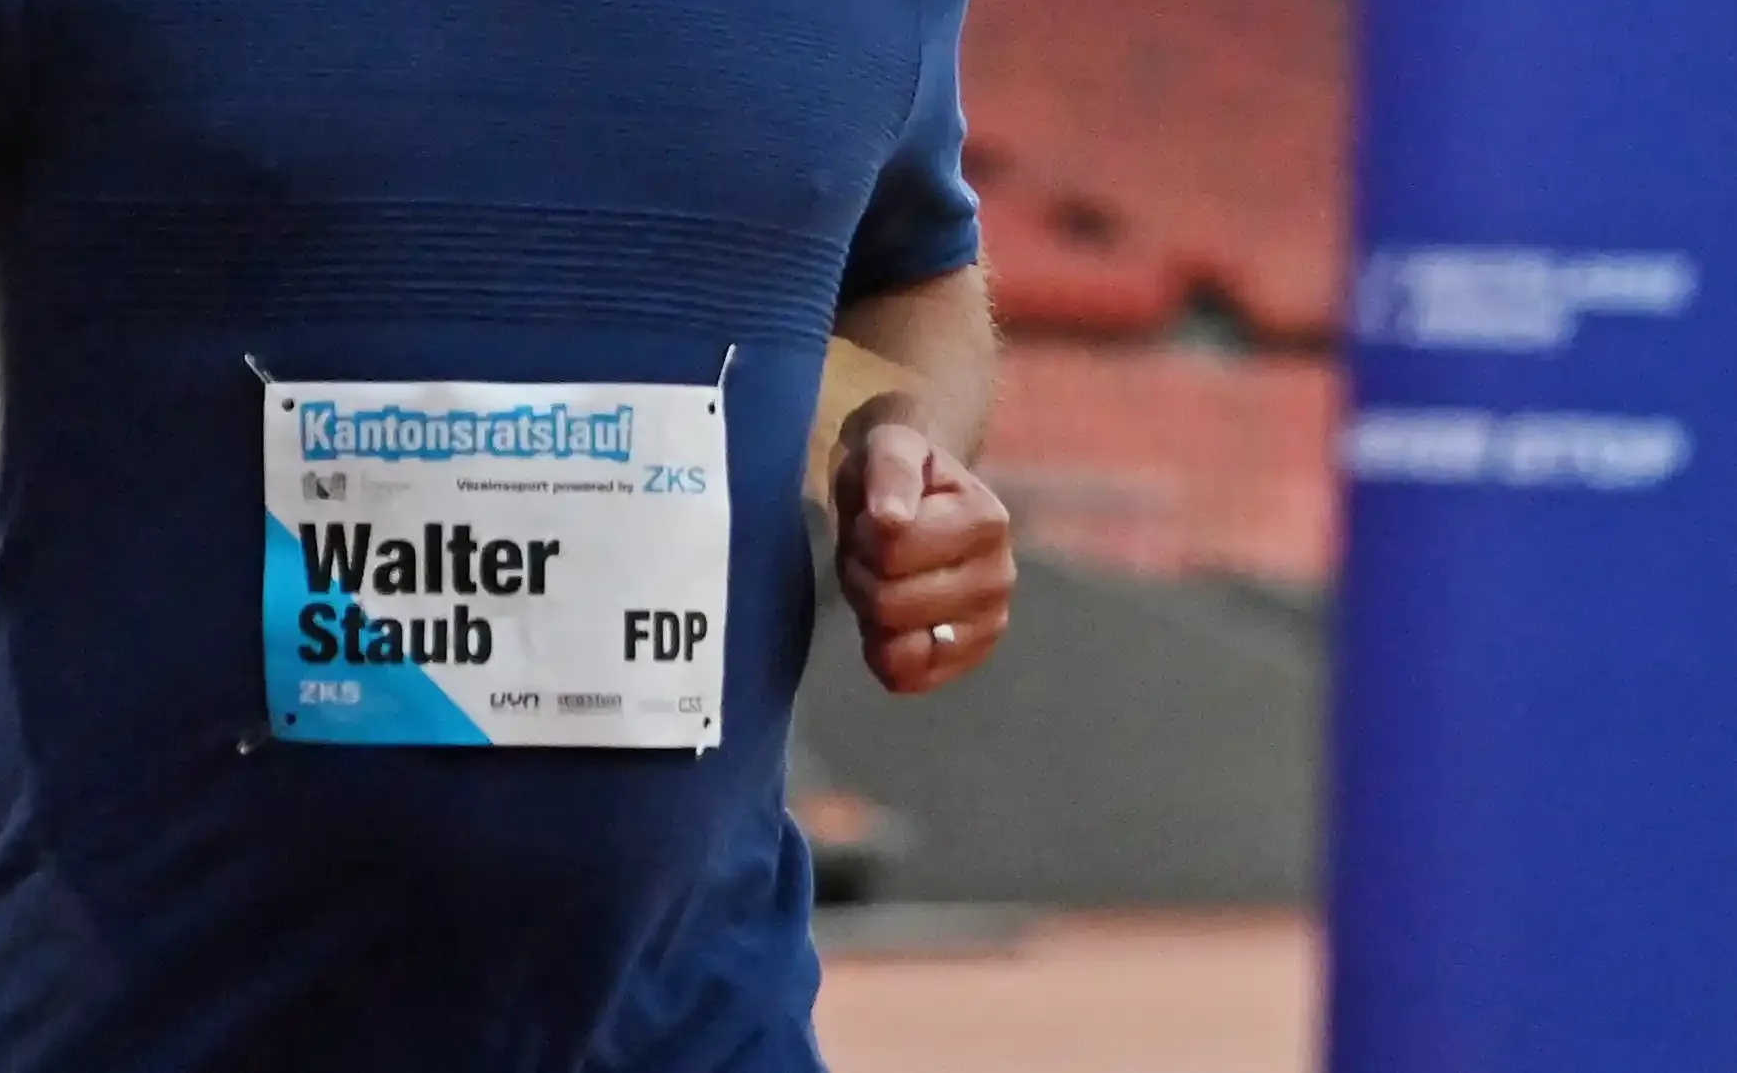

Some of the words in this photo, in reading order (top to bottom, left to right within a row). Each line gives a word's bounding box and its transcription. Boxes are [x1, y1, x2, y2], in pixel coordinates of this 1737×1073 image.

[302, 405, 632, 457] Kantonsratslauf
[643, 466, 706, 494] ZKS
[298, 522, 560, 596] Walter
[297, 602, 493, 665] Staub
[624, 610, 708, 662] FDP
[300, 680, 361, 704] ZKS
